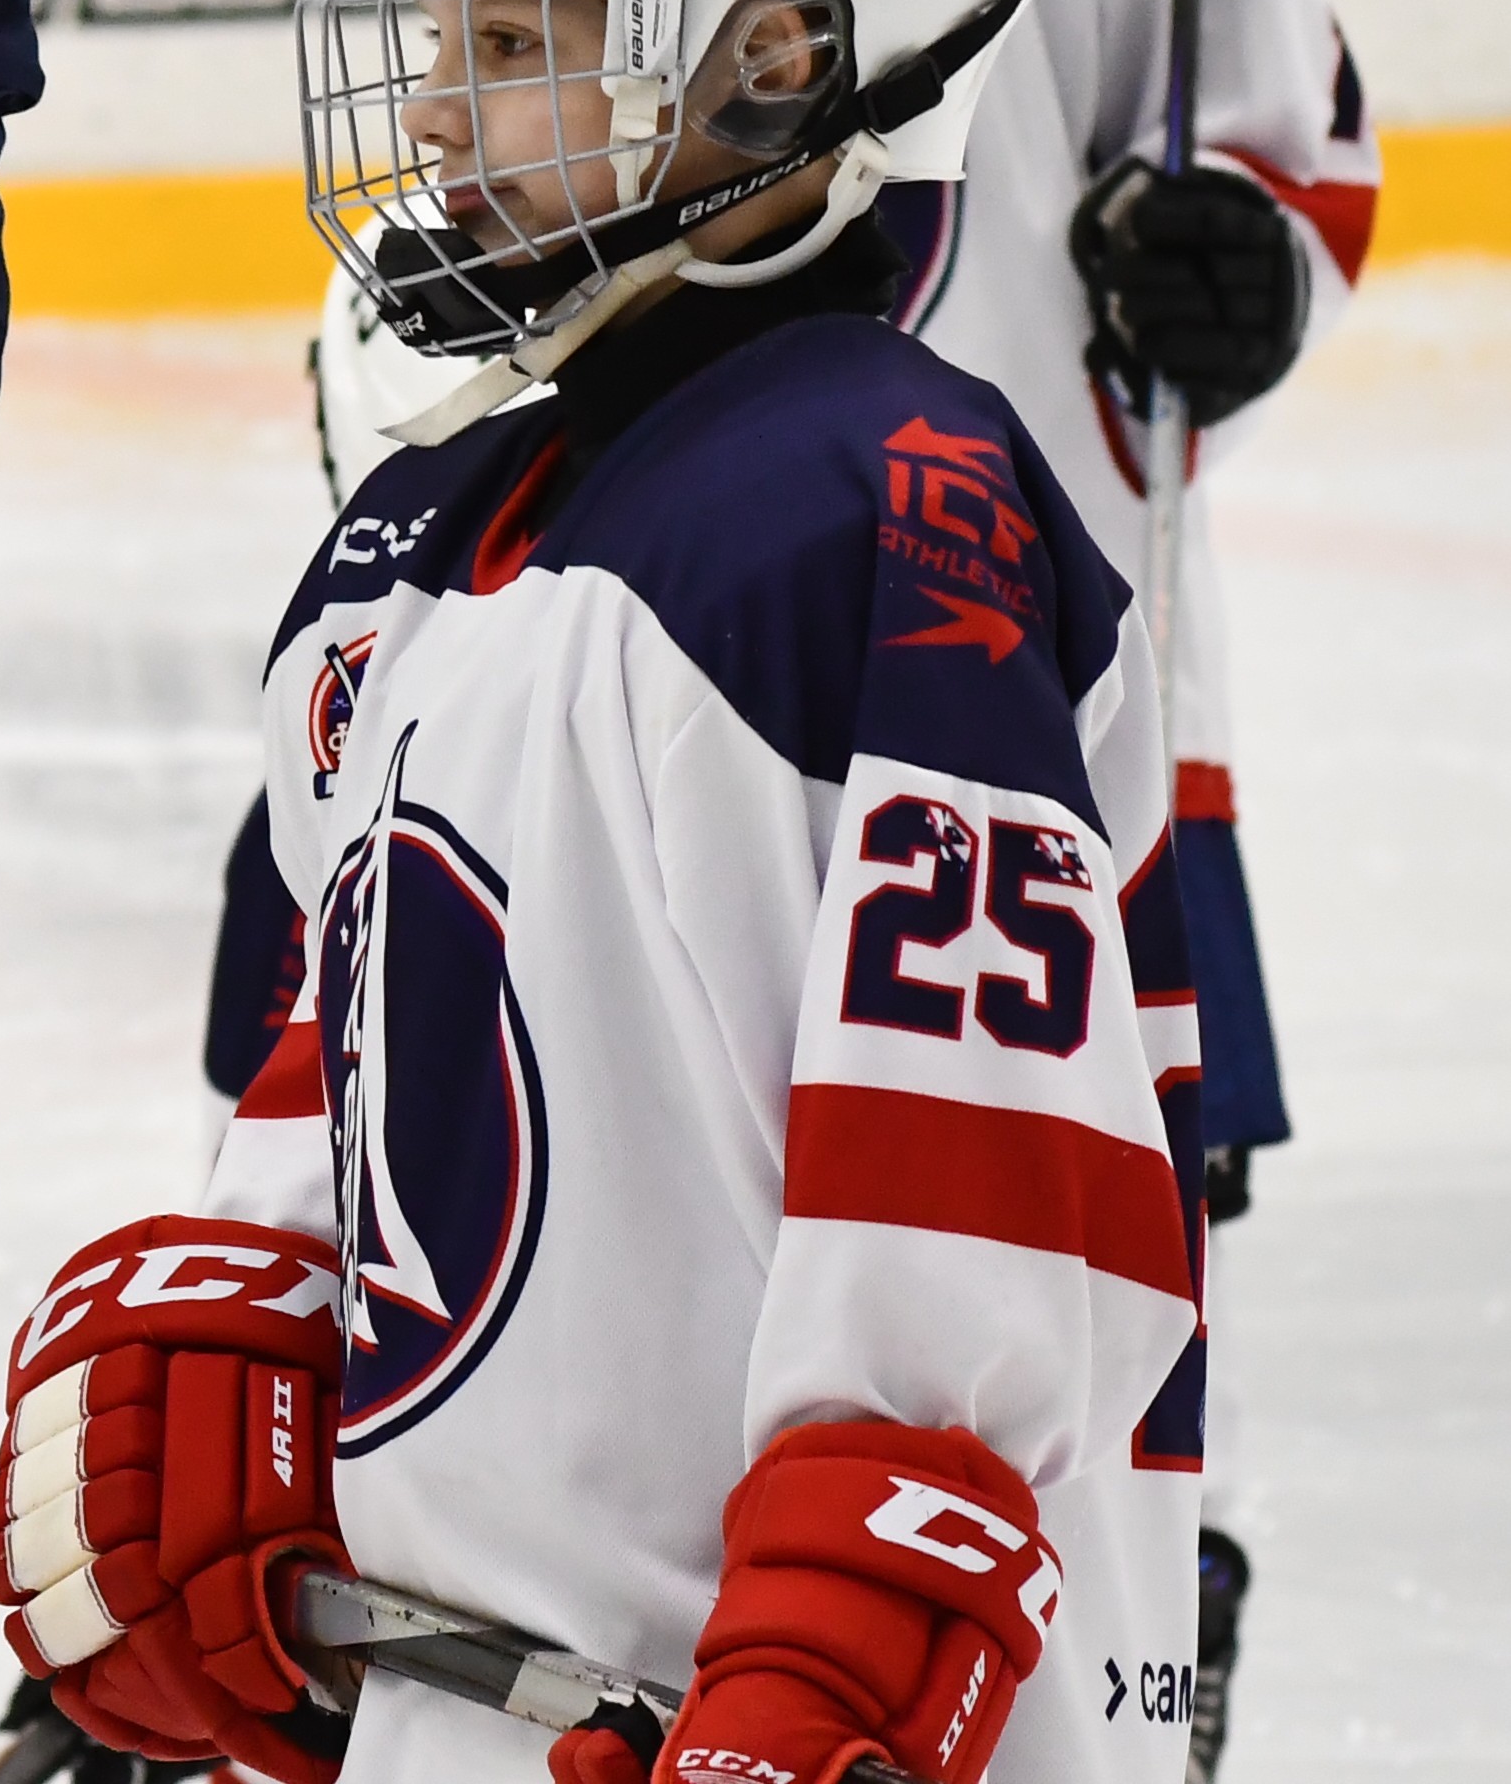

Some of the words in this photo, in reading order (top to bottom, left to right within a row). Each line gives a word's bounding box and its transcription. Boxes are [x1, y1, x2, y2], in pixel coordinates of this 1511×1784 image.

[677, 152, 810, 227] BAUER
[878, 524, 1038, 618] ATHLETIC
[839, 793, 1096, 1060] 25
[676, 1747, 797, 1784] CCM
